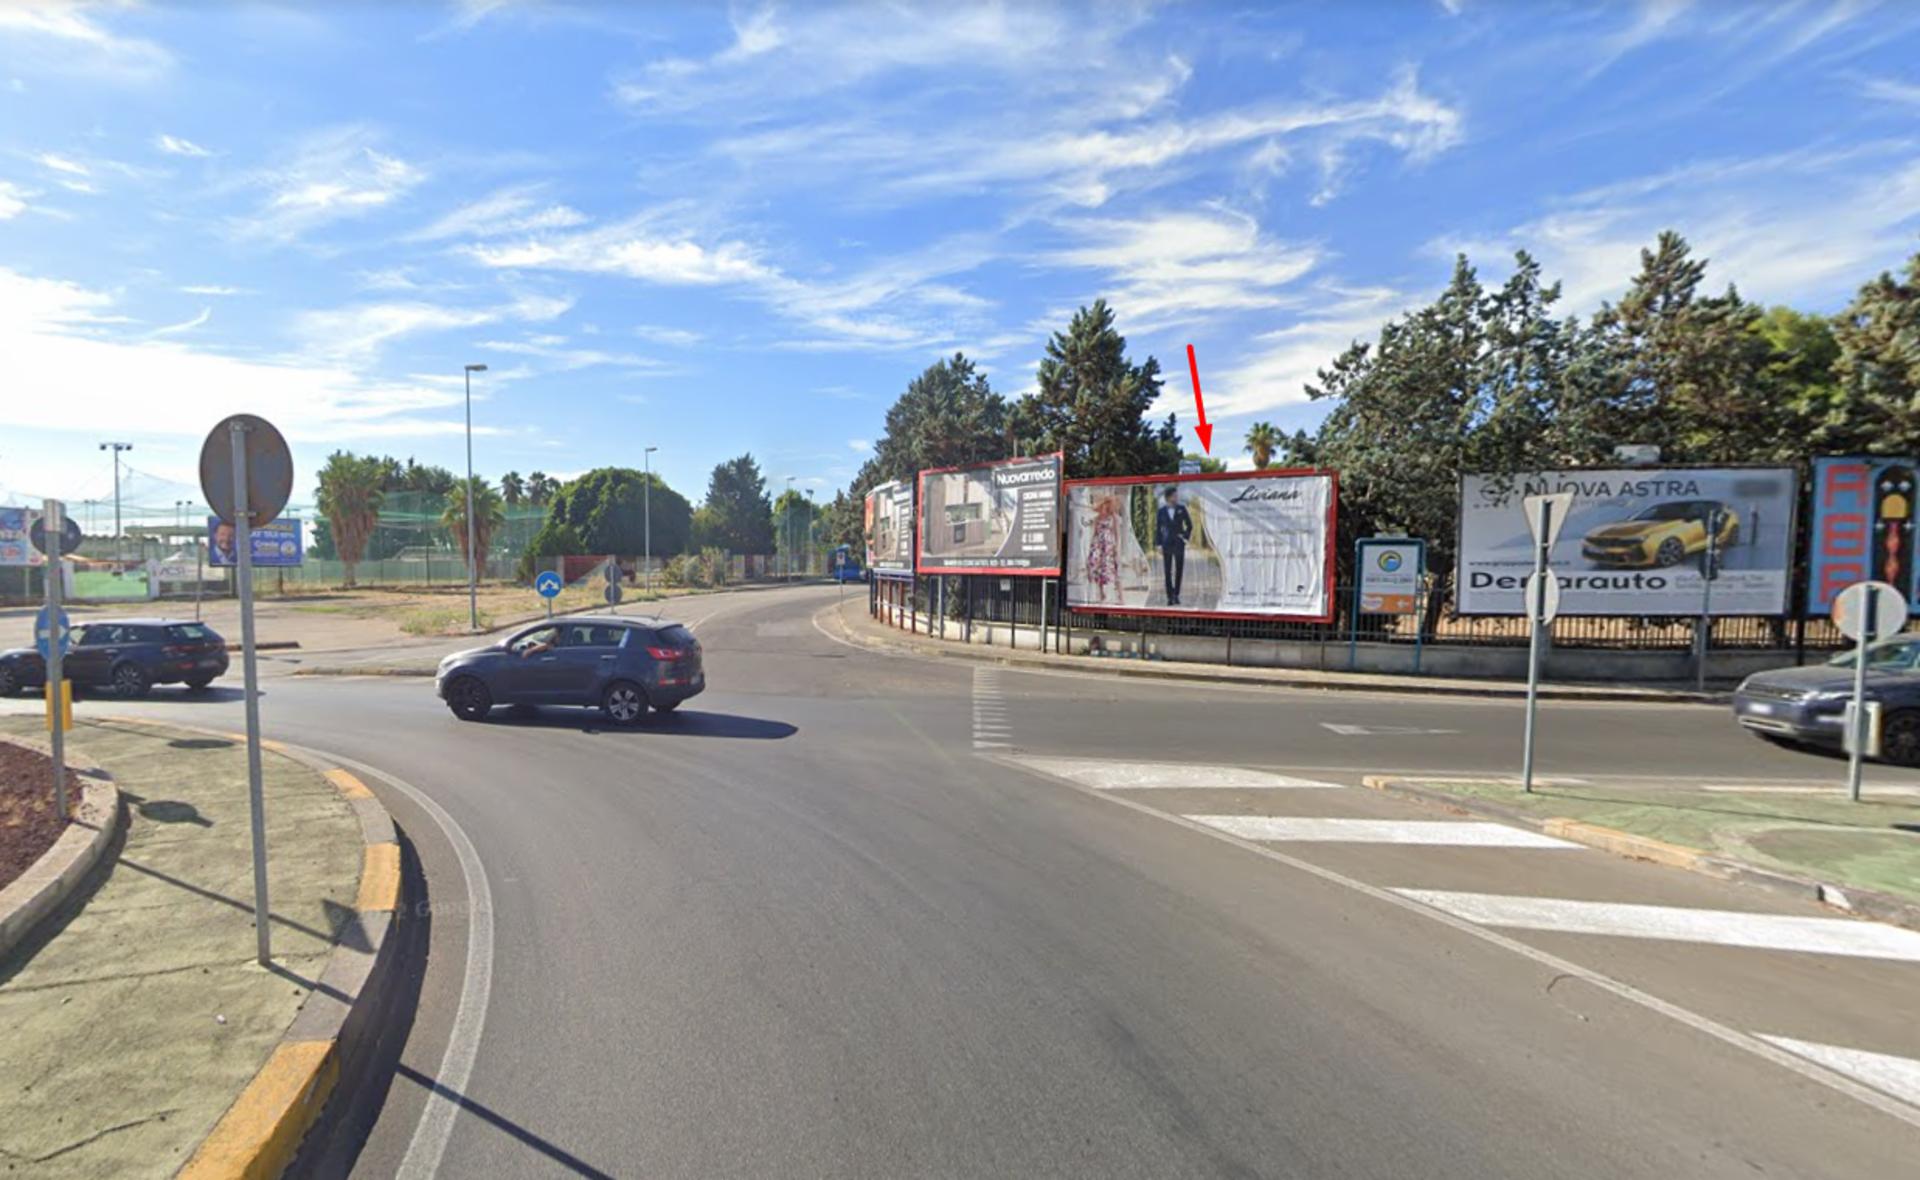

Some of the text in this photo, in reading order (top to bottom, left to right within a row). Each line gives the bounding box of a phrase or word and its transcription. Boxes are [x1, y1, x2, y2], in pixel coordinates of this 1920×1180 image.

[996, 469, 1056, 485] Nuovarredo
[1230, 485, 1301, 504] Liviana
[1618, 480, 1700, 498] ASTRA
